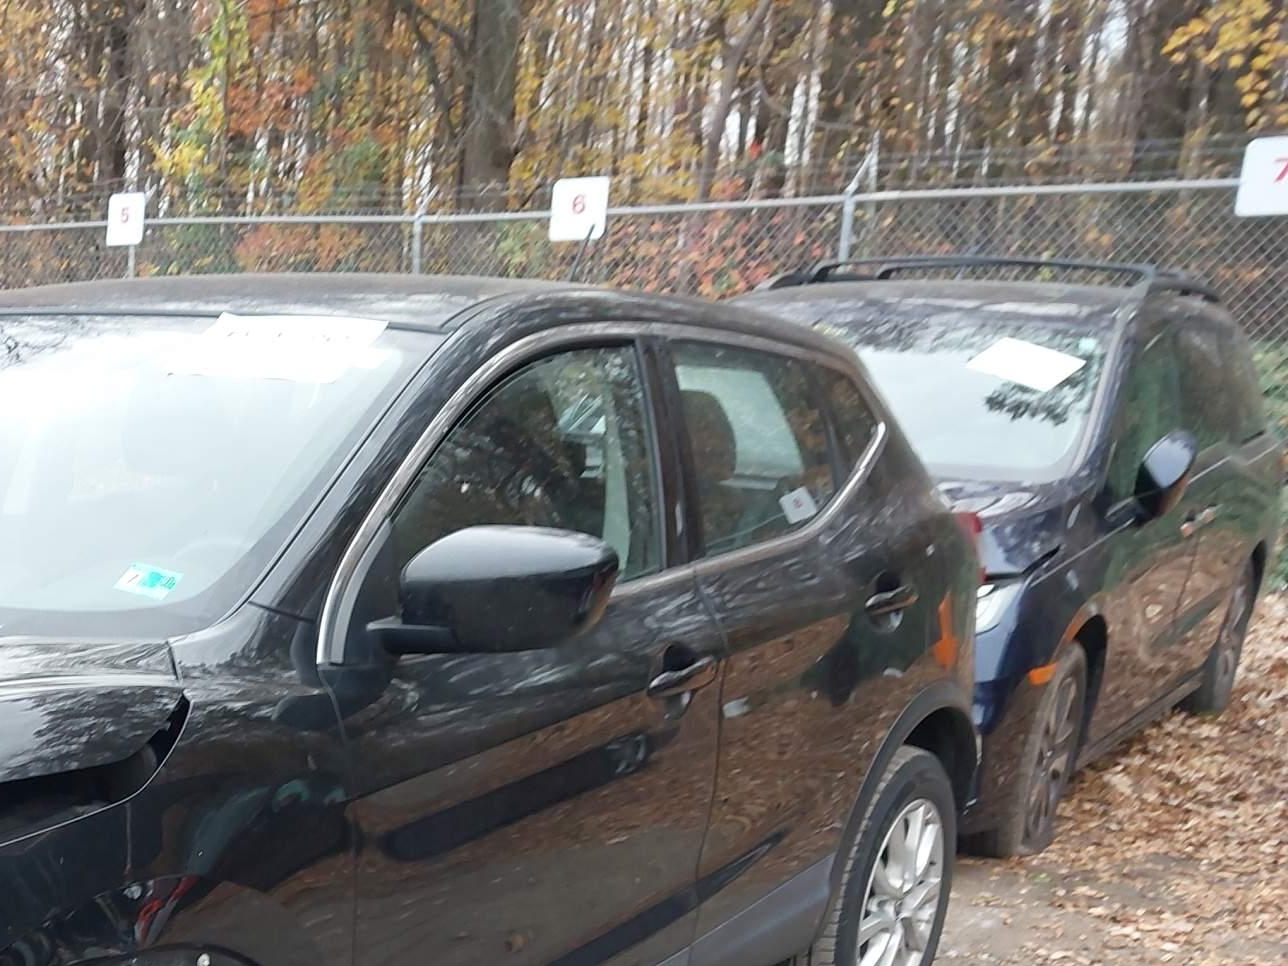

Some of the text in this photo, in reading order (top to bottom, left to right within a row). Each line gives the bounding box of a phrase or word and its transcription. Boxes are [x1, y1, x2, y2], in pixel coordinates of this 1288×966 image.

[1273, 157, 1288, 184] 7
[121, 206, 130, 223] 5
[572, 193, 586, 215] 6
